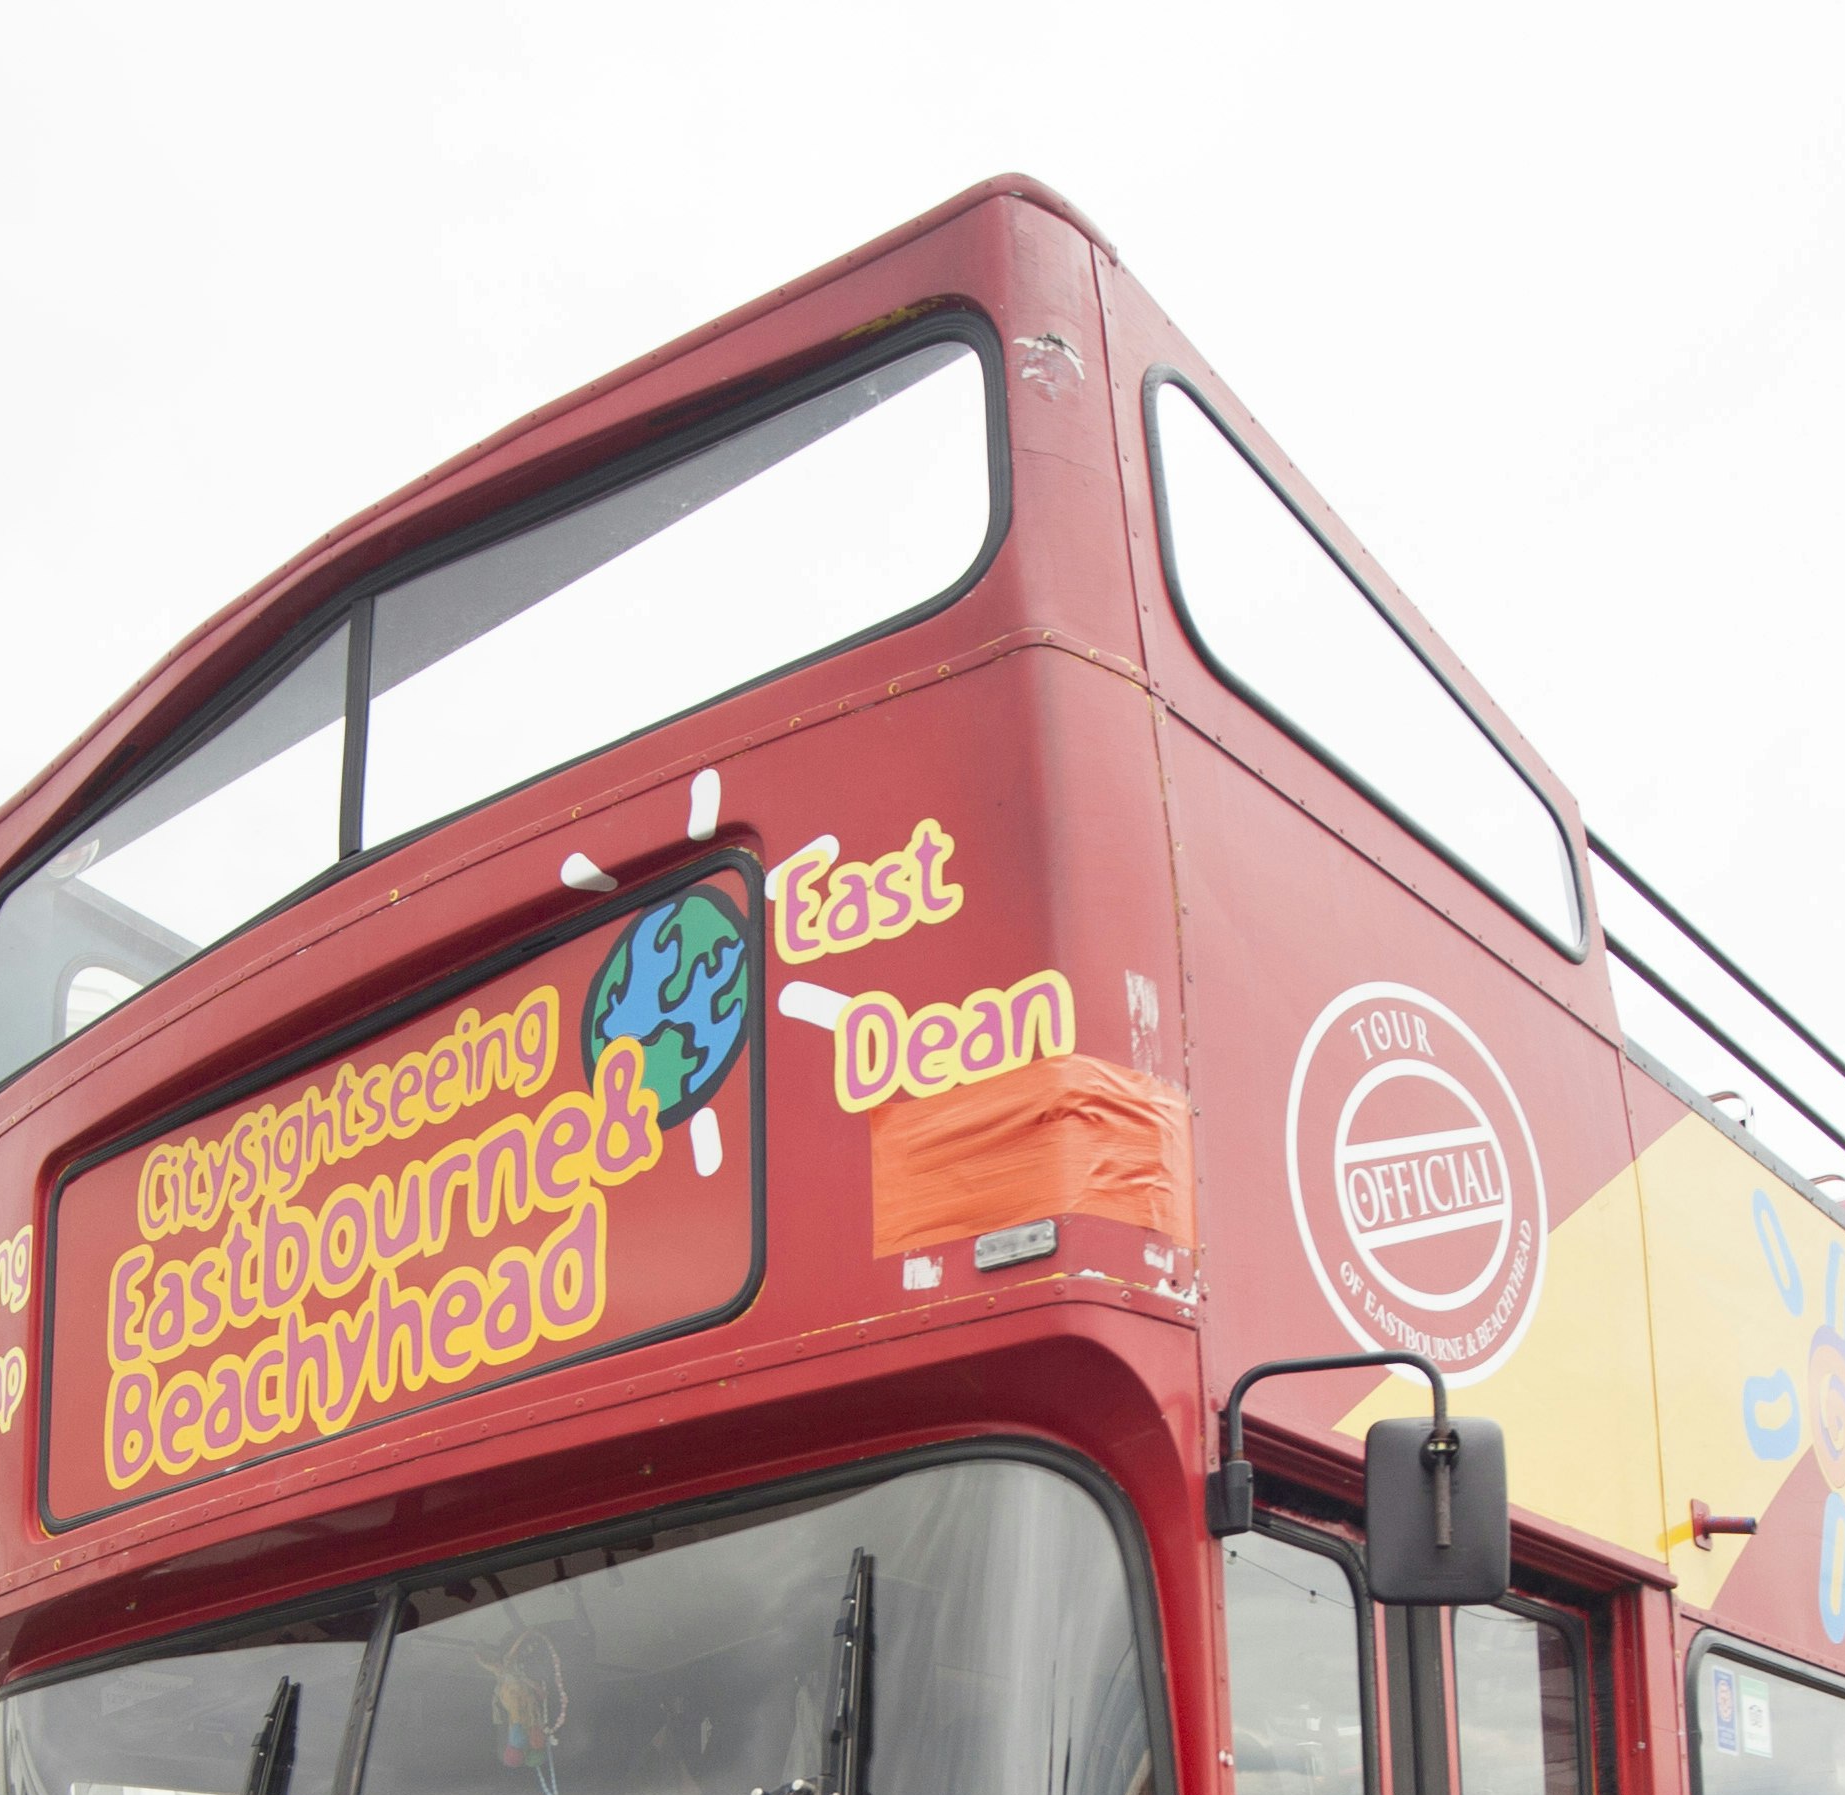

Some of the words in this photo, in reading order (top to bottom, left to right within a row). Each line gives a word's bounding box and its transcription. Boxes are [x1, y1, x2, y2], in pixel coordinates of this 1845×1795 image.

[774, 818, 964, 964] East
[834, 969, 1076, 1113] Dean
[1349, 1010, 1435, 1062] TOUR
[1346, 1148, 1503, 1230] OFFICIAL
[104, 1186, 607, 1489] Beachyhead
[1340, 1260, 1364, 1302] OF
[1363, 1293, 1467, 1362] EASTBOURNE
[1466, 1336, 1480, 1358] &
[1476, 1219, 1533, 1346] BEACHYHEAD
